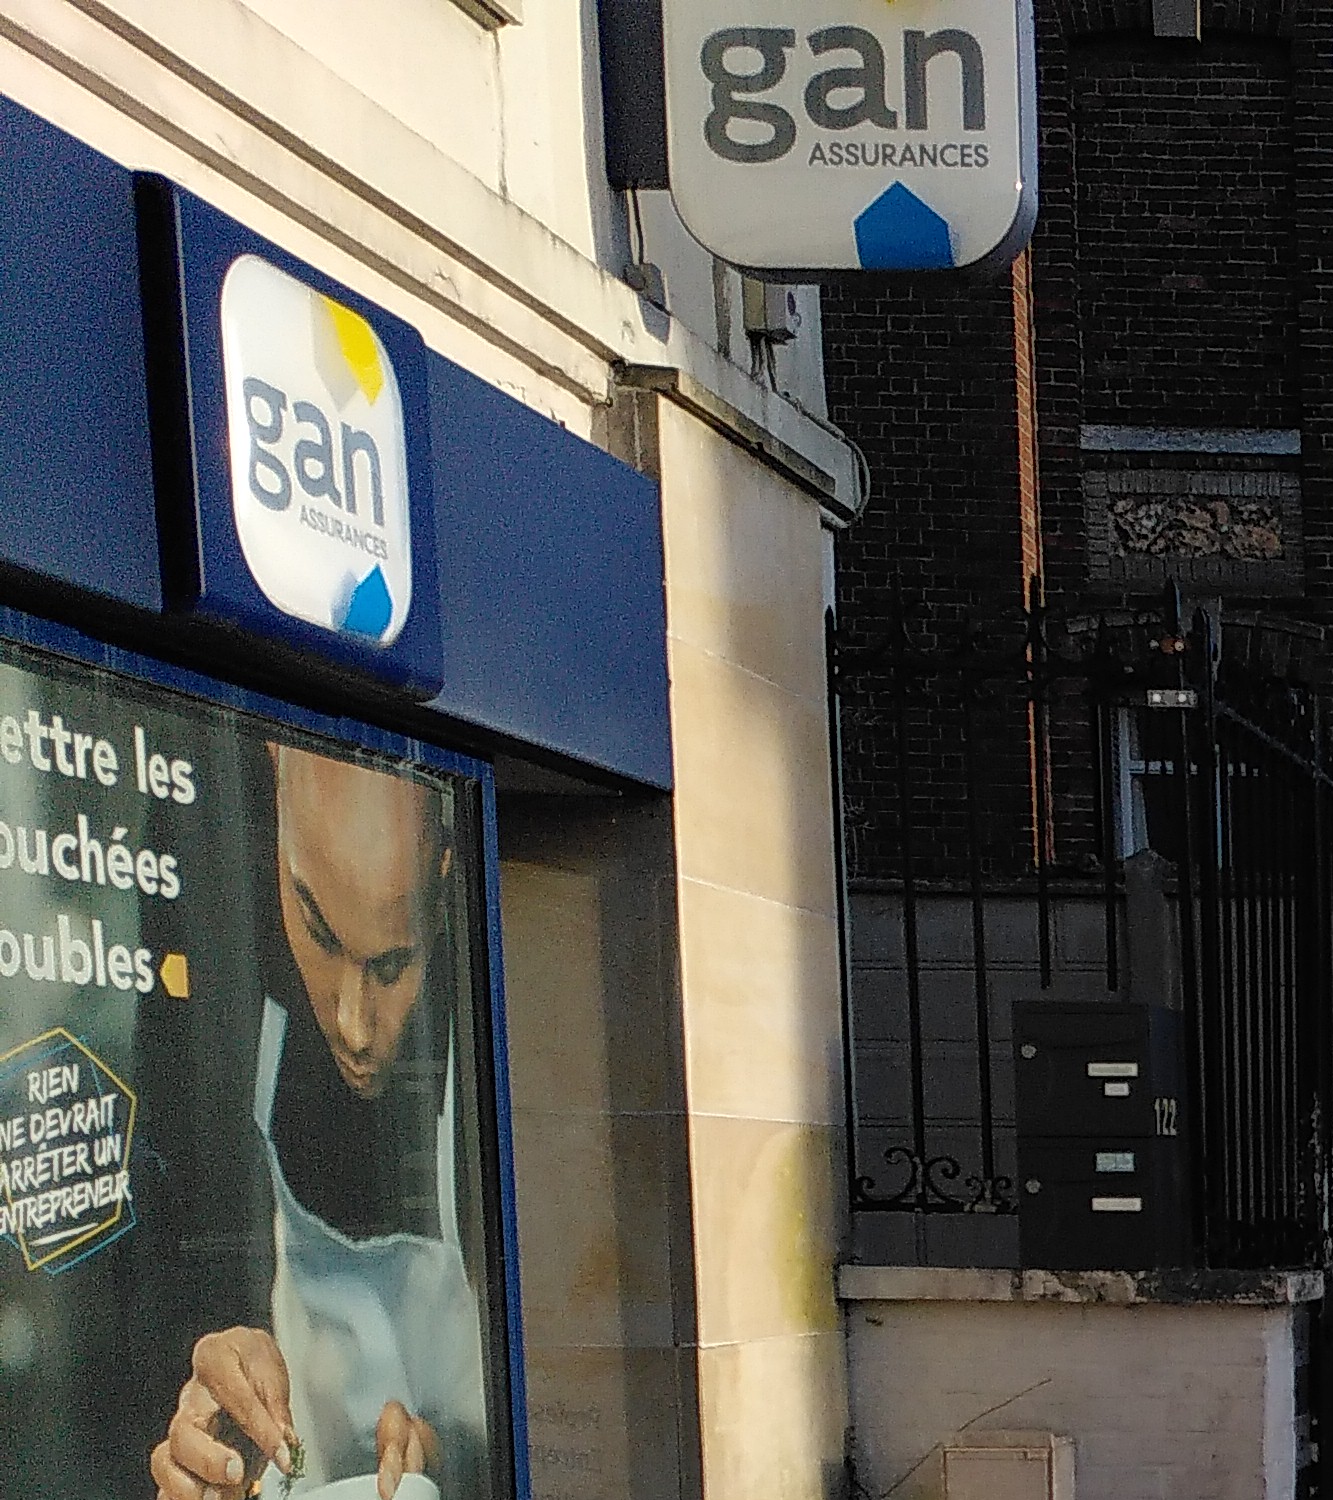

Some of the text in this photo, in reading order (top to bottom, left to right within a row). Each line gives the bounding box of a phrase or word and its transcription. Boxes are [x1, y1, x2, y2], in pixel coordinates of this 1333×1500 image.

[700, 25, 986, 163] gan
[808, 142, 990, 168] ASSURANCES
[243, 377, 385, 527] gan
[299, 504, 388, 560] ASSURANCES
[0, 710, 196, 804] ettre les
[28, 1063, 79, 1105] RIEN
[0, 1093, 119, 1151] NE DEVRAIT
[1154, 1097, 1177, 1136] 122
[94, 1133, 122, 1171] UN
